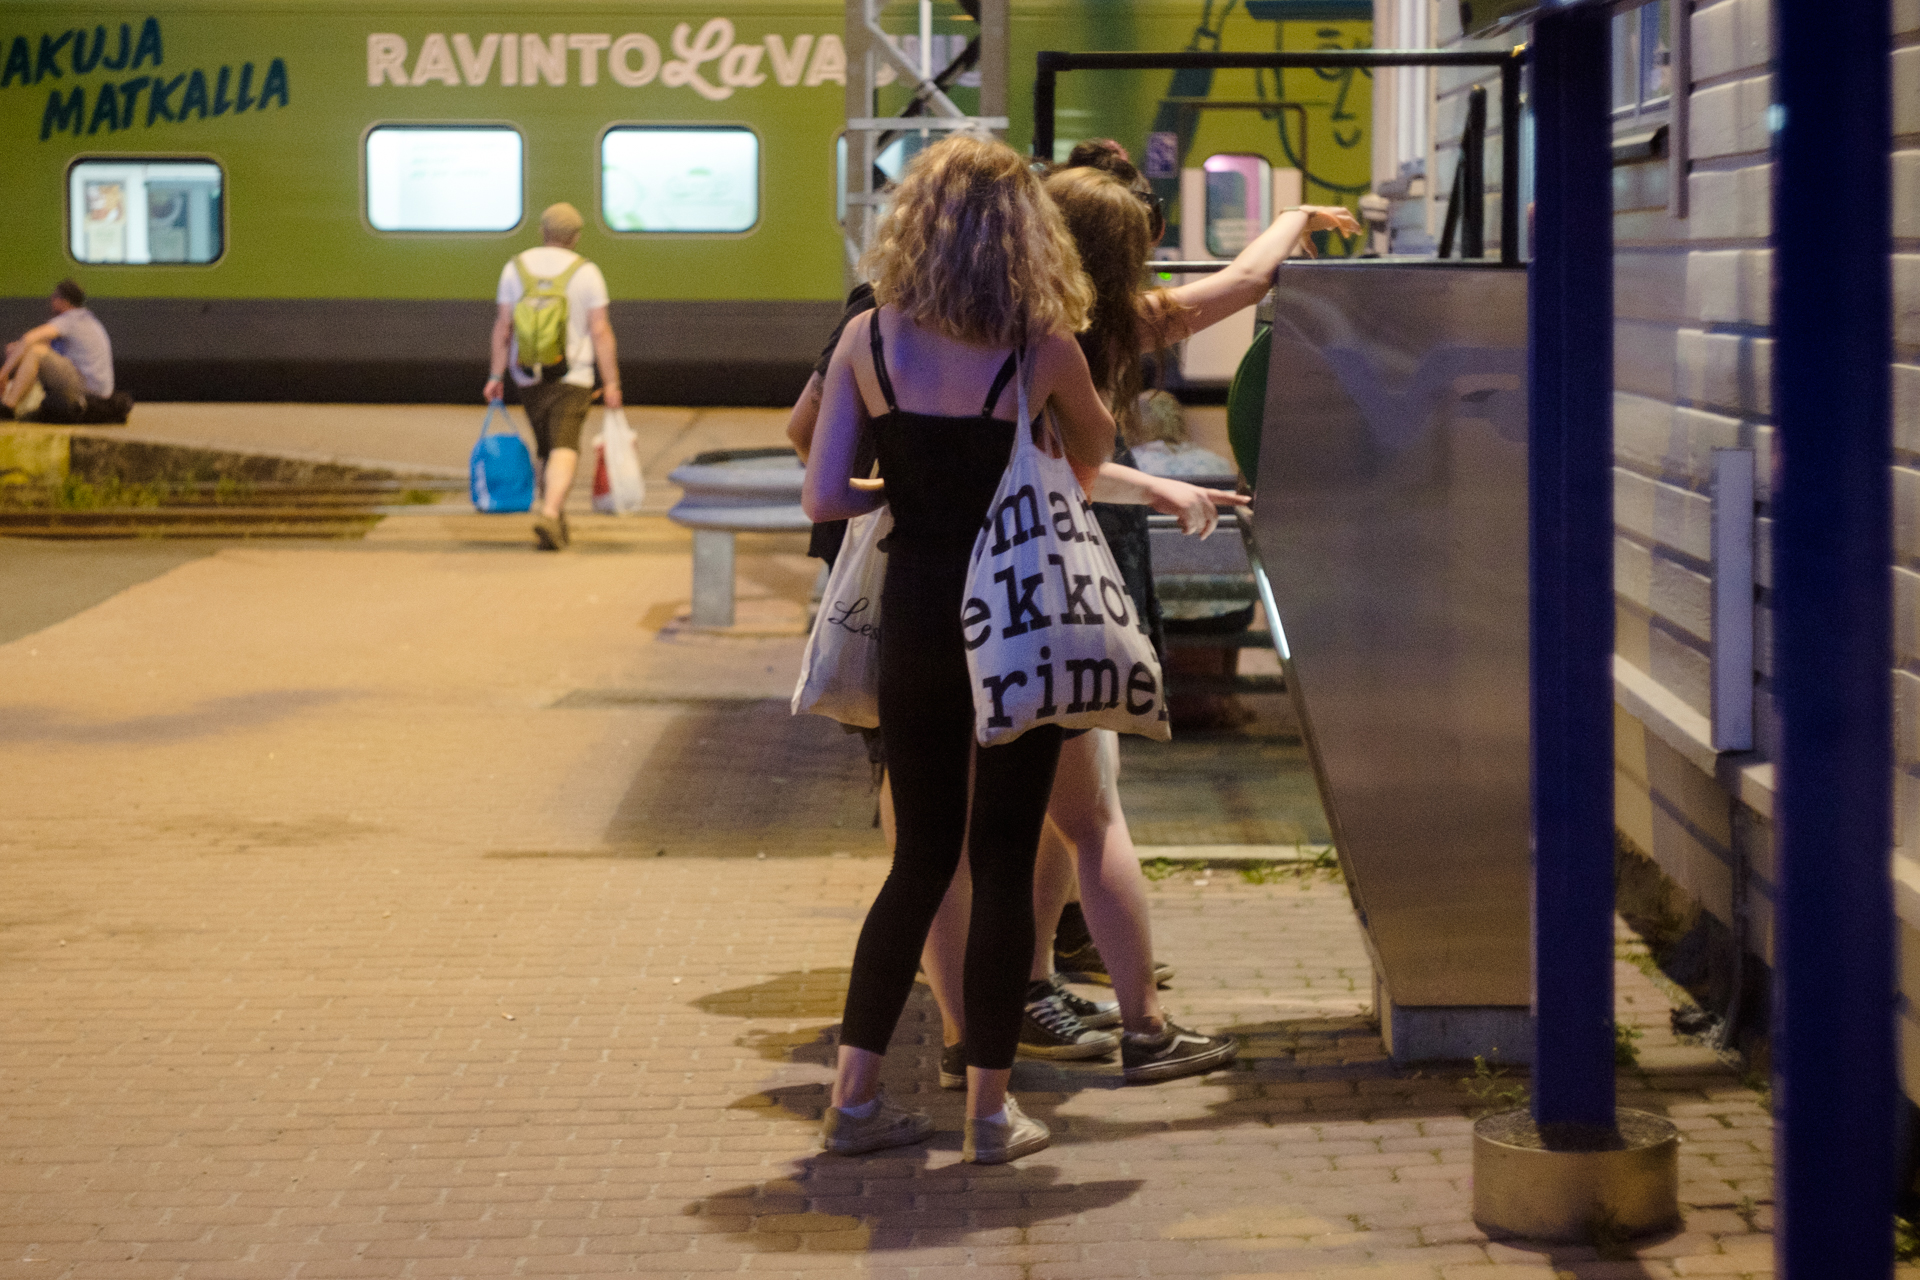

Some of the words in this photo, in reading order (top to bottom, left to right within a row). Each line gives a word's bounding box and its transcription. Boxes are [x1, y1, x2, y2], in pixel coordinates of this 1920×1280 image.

[0, 16, 163, 88] AKUJA
[39, 57, 289, 141] MATKALLA
[962, 553, 1132, 650] ekko
[982, 645, 1169, 728] rime
